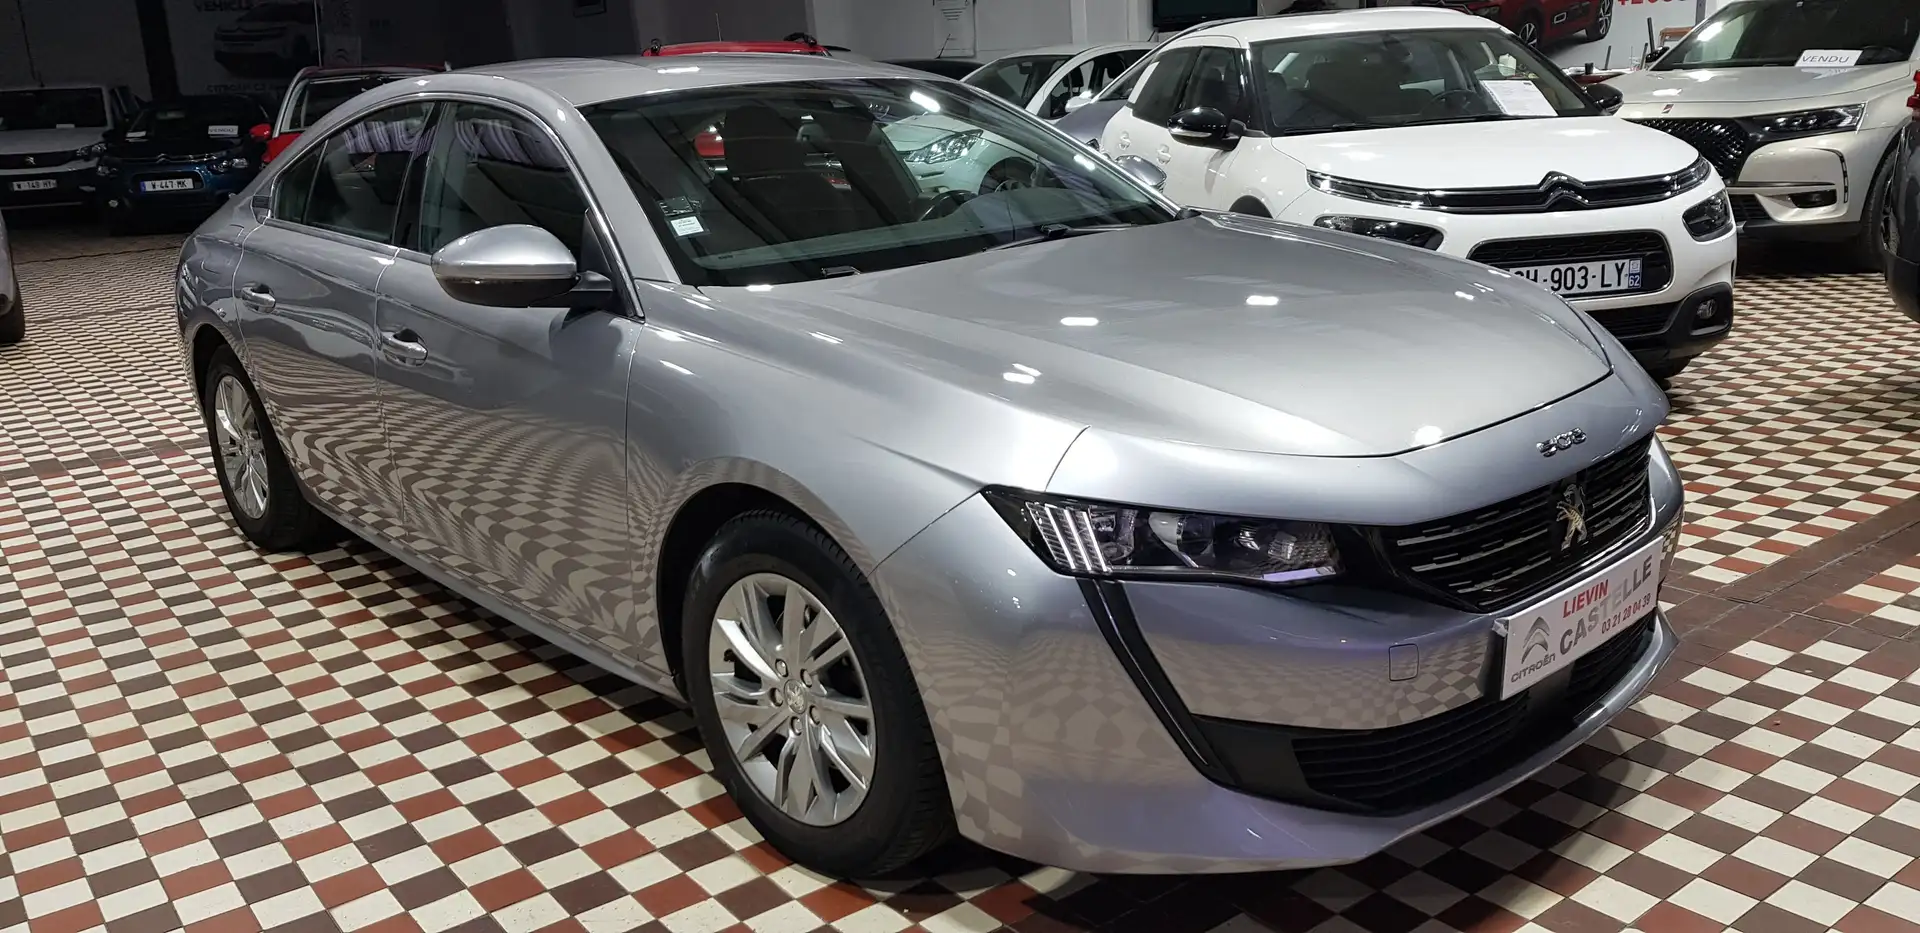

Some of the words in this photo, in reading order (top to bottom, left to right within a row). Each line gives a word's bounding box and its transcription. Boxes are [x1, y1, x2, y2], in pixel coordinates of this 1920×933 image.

[1802, 55, 1850, 63] VENDU
[1629, 275, 1640, 287] 62
[1536, 427, 1587, 457] 508
[1559, 555, 1652, 655] CASTELLE
[1562, 579, 1609, 618] LIEVIN
[1601, 618, 1611, 634] 03
[1612, 611, 1621, 628] 21
